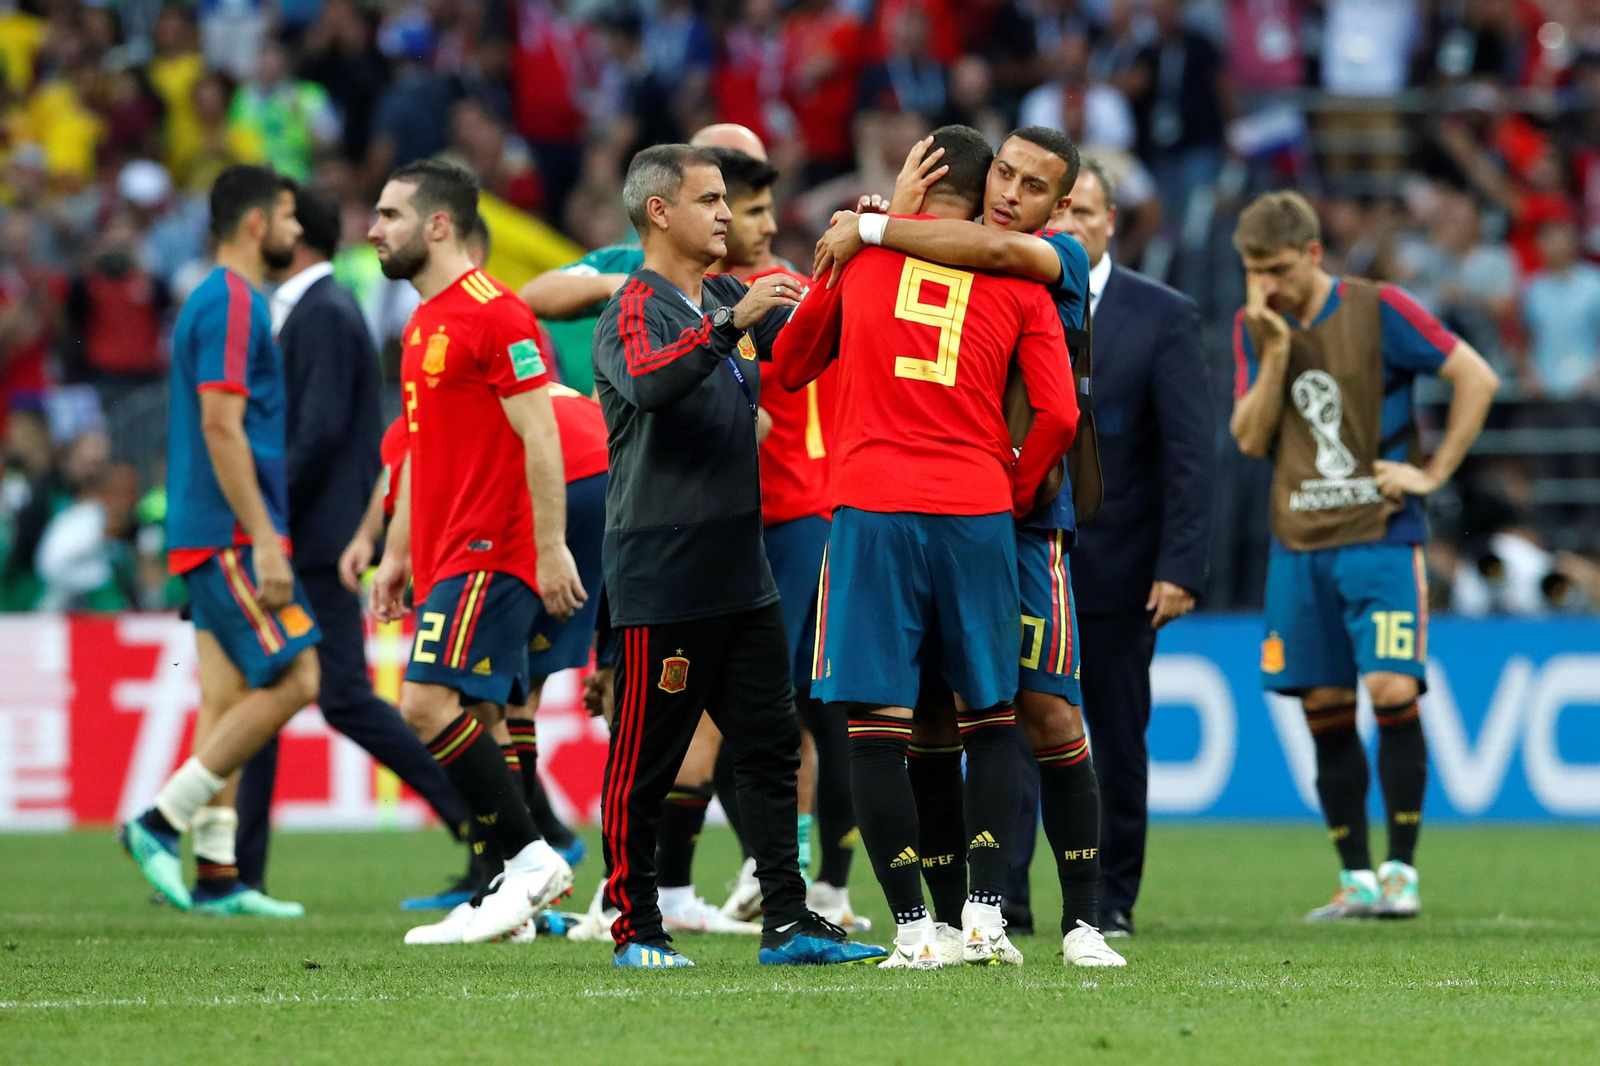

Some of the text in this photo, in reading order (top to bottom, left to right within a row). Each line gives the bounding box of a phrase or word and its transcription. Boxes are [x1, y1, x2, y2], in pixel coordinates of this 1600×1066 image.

[894, 256, 975, 387] 9
[413, 611, 446, 664] 2
[1371, 610, 1415, 660] 16
